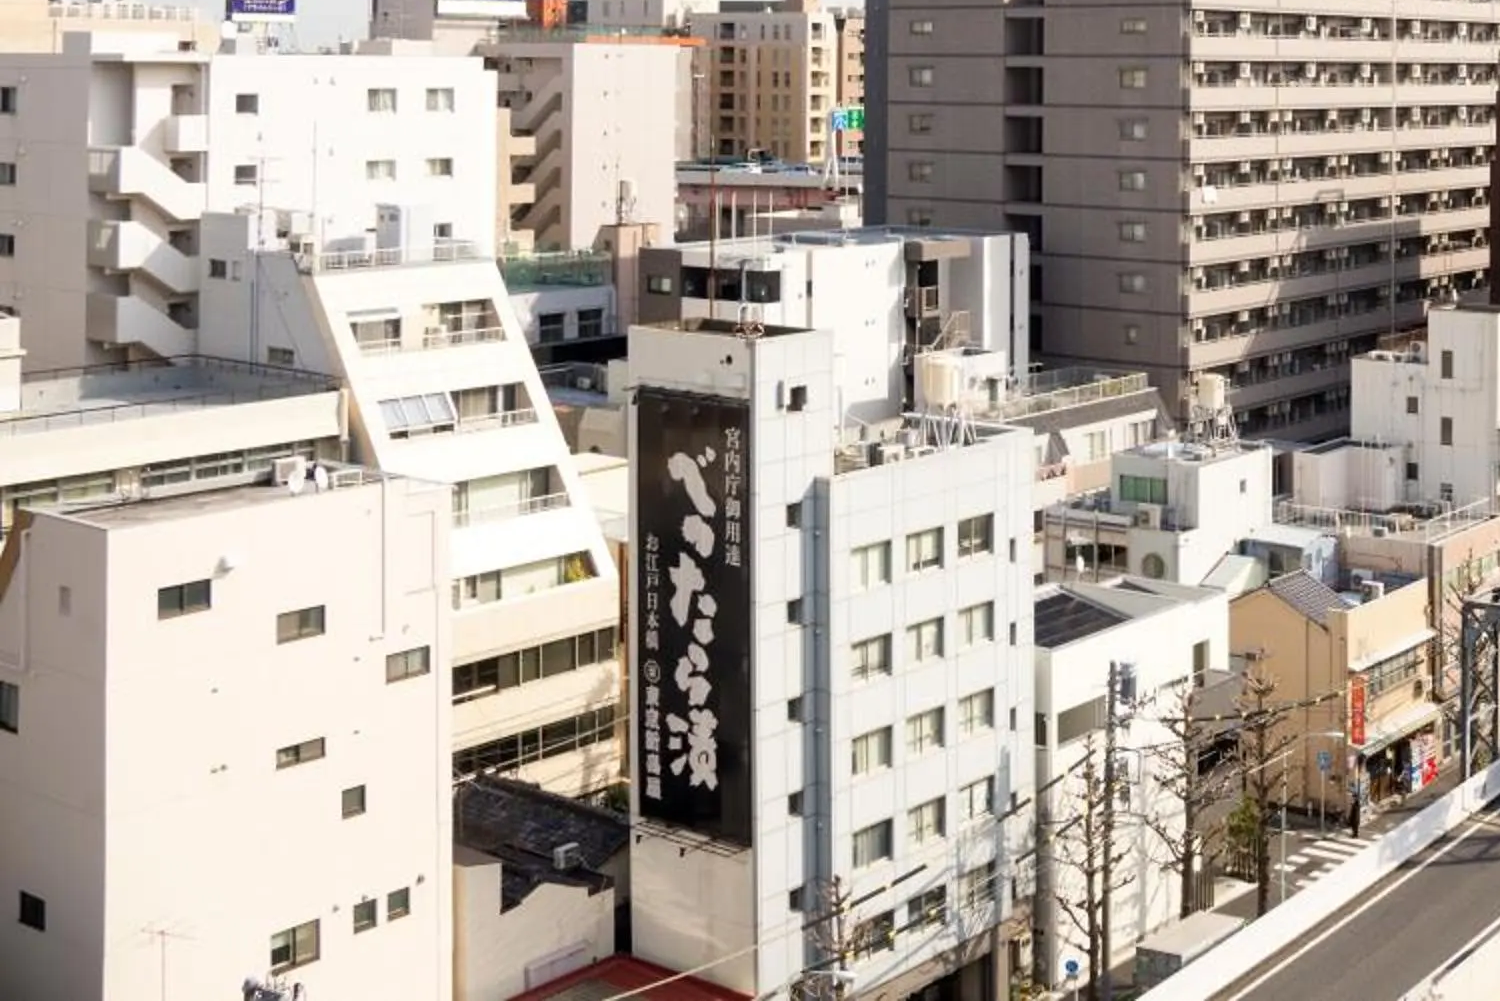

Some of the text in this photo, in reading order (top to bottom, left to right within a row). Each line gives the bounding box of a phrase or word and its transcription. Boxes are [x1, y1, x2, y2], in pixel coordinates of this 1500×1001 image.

[724, 426, 741, 567] 宮内庁御用達
[666, 446, 719, 791] べったら漬
